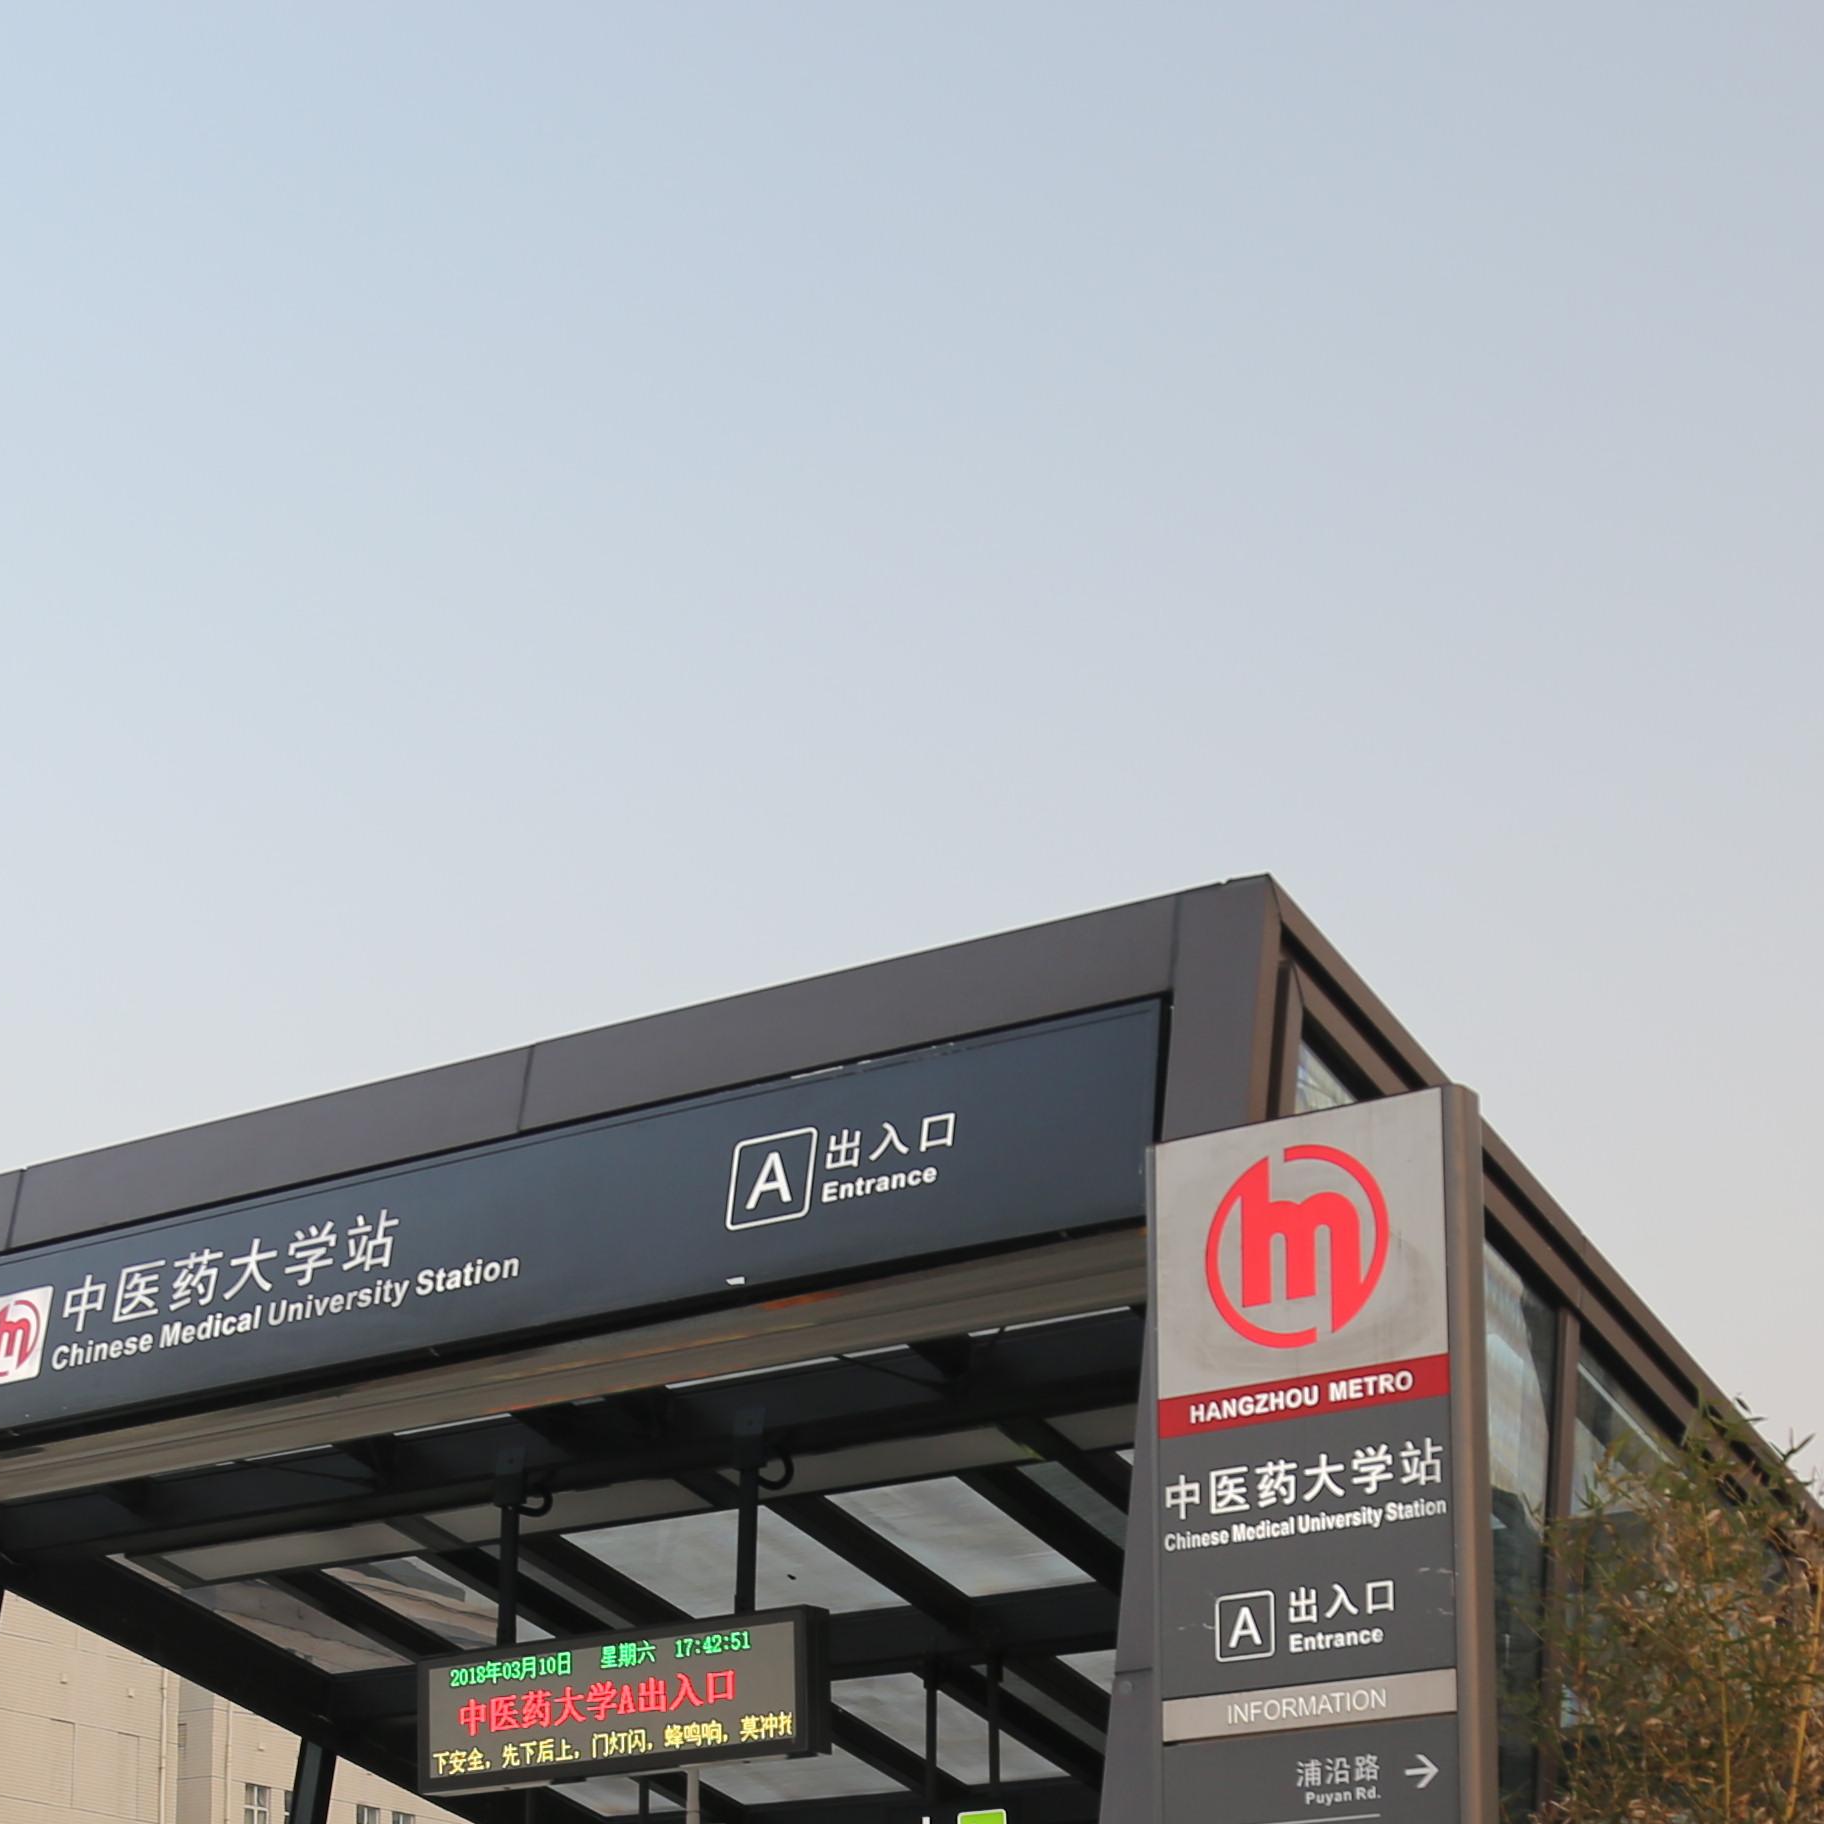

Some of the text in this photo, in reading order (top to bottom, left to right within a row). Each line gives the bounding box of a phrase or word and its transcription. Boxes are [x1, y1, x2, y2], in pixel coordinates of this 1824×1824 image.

[824, 1111, 956, 1170] 出入口
[745, 1151, 793, 1210] A
[822, 1164, 938, 1203] Entrance
[62, 1209, 400, 1333] 中医药大学站
[51, 1256, 520, 1370] Chinese Medical University Station
[1189, 1370, 1413, 1424] HANGZHOU METRO
[1165, 1437, 1444, 1520] 中医药大学站
[1164, 1498, 1447, 1552] Chinese Medical University Station
[1228, 1606, 1262, 1648] A
[1288, 1580, 1396, 1624] 出入口
[449, 1631, 751, 1687] 2018年03月10日 星期六 17:42:51
[1289, 1627, 1384, 1653] Entrance
[458, 1669, 736, 1736] 中医药大学A出入口
[1227, 1688, 1387, 1725] INFORMATION
[1296, 1753, 1380, 1787] 浦沿路
[1305, 1786, 1382, 1807] Puyan Rd.
